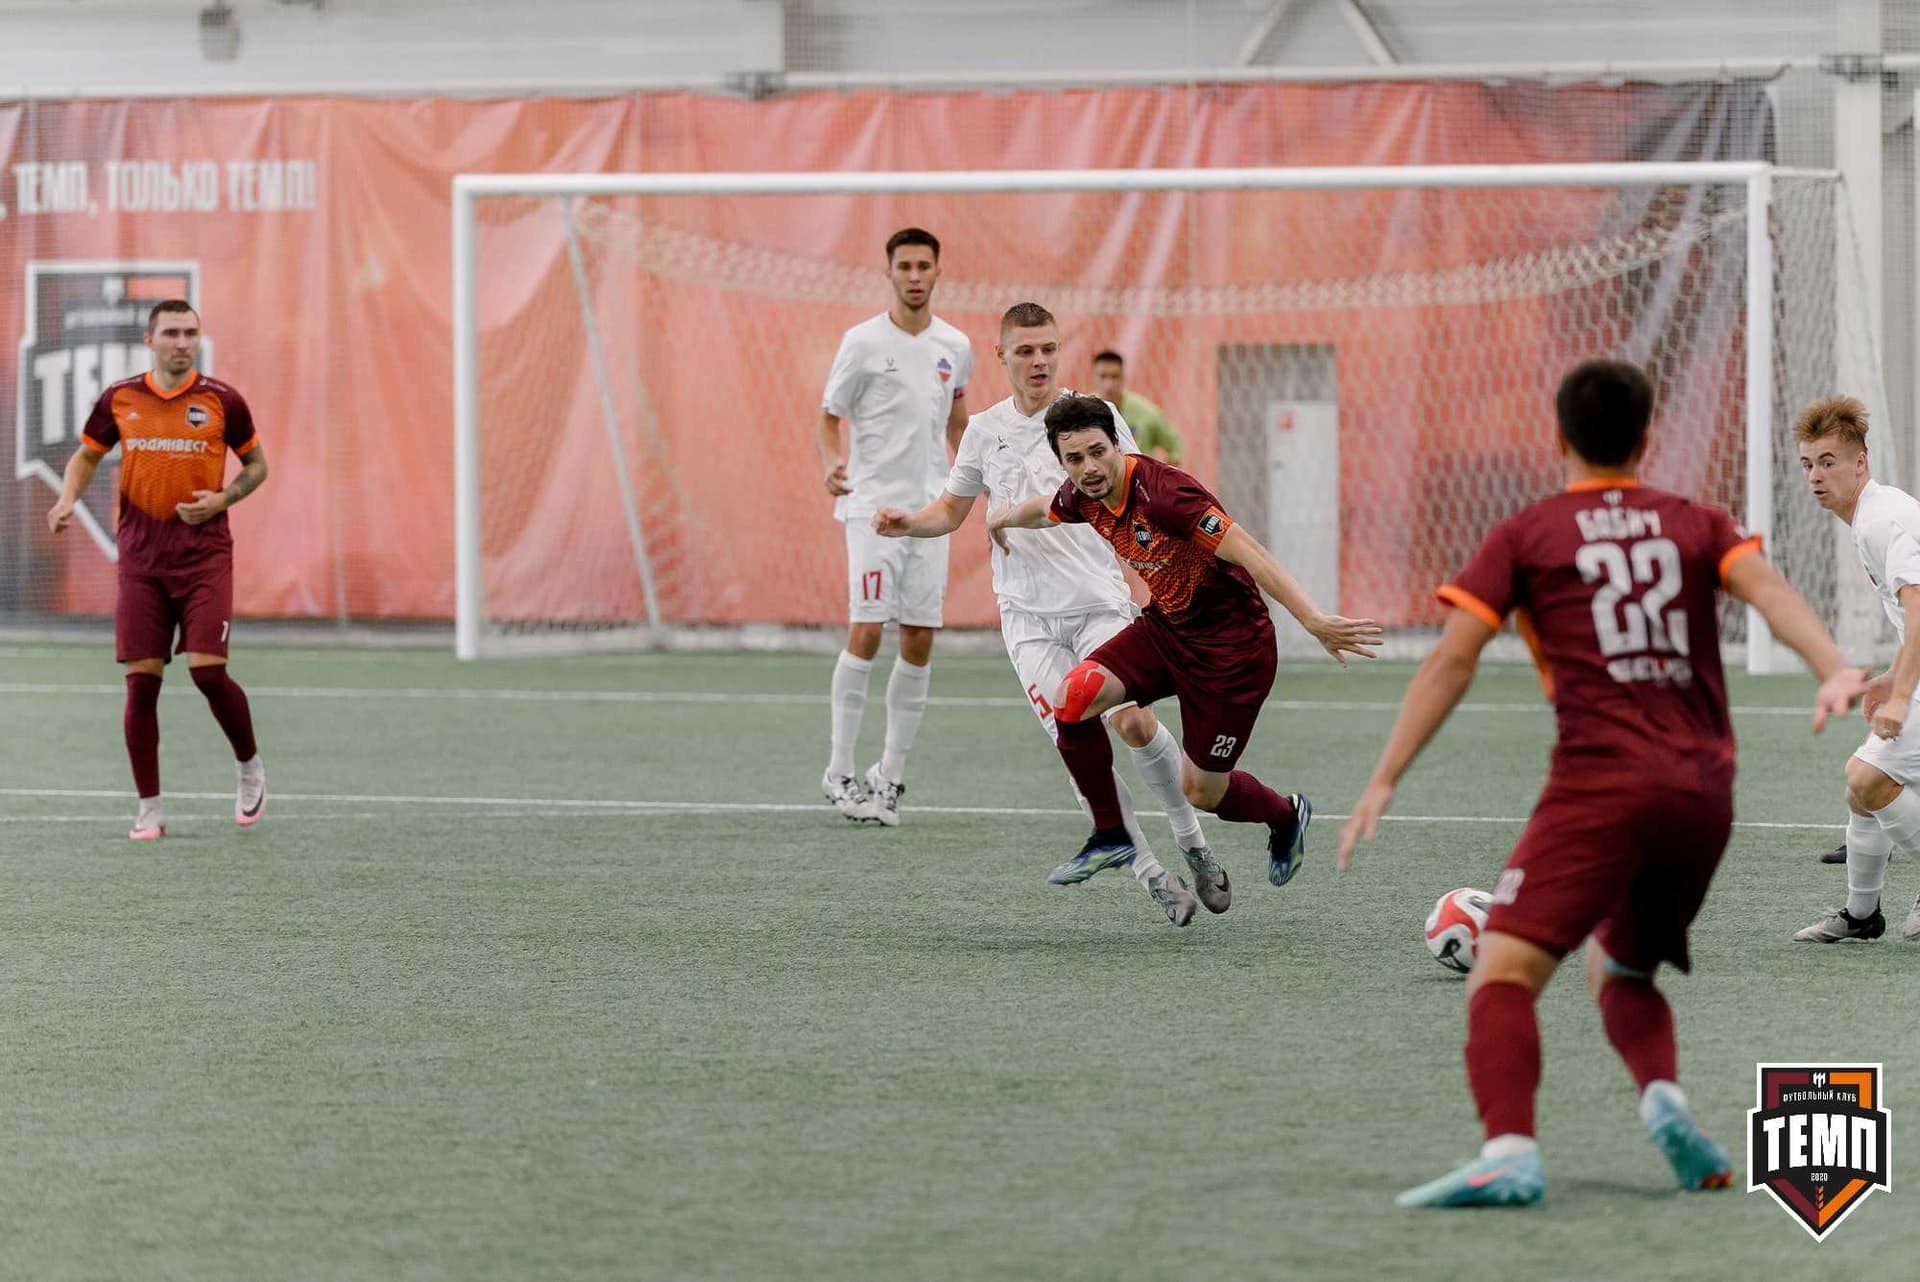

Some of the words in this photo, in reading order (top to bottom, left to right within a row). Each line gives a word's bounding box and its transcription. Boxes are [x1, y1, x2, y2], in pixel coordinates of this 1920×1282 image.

[105, 160, 219, 212] ТОЛЬКО
[862, 571, 881, 601] 17
[1575, 538, 1690, 658] 22
[1028, 683, 1053, 720] 5
[1210, 734, 1237, 758] 23
